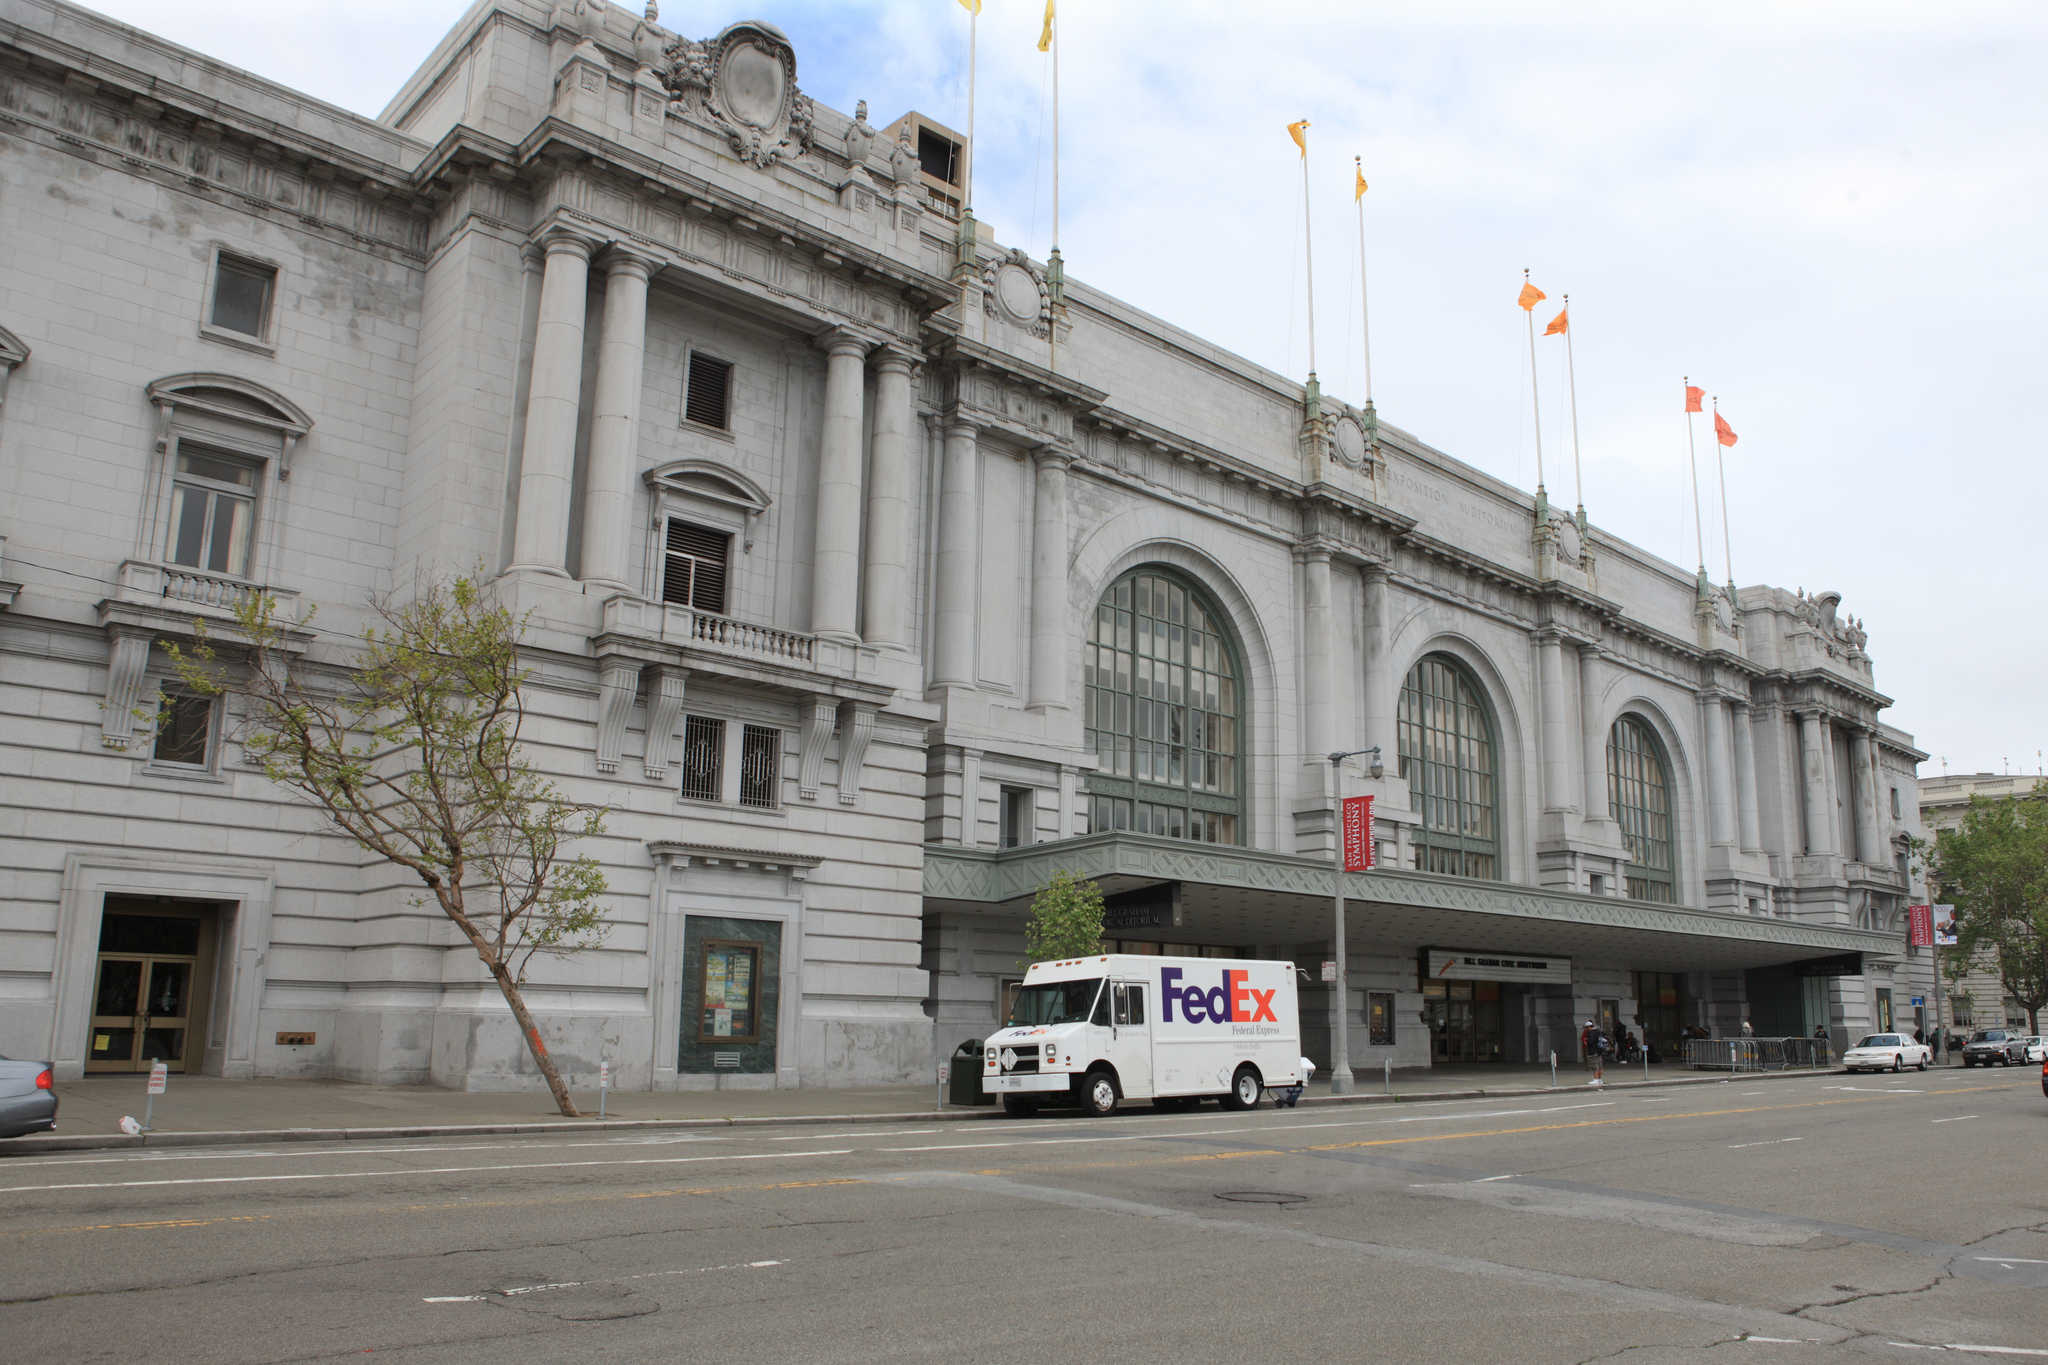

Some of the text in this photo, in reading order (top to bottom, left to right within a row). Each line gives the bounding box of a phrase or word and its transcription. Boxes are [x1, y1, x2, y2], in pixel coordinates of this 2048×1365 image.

[1352, 802, 1360, 867] SYMPHONY
[1161, 967, 1278, 1024] FedEx
[1232, 1024, 1281, 1037] Federal Express
